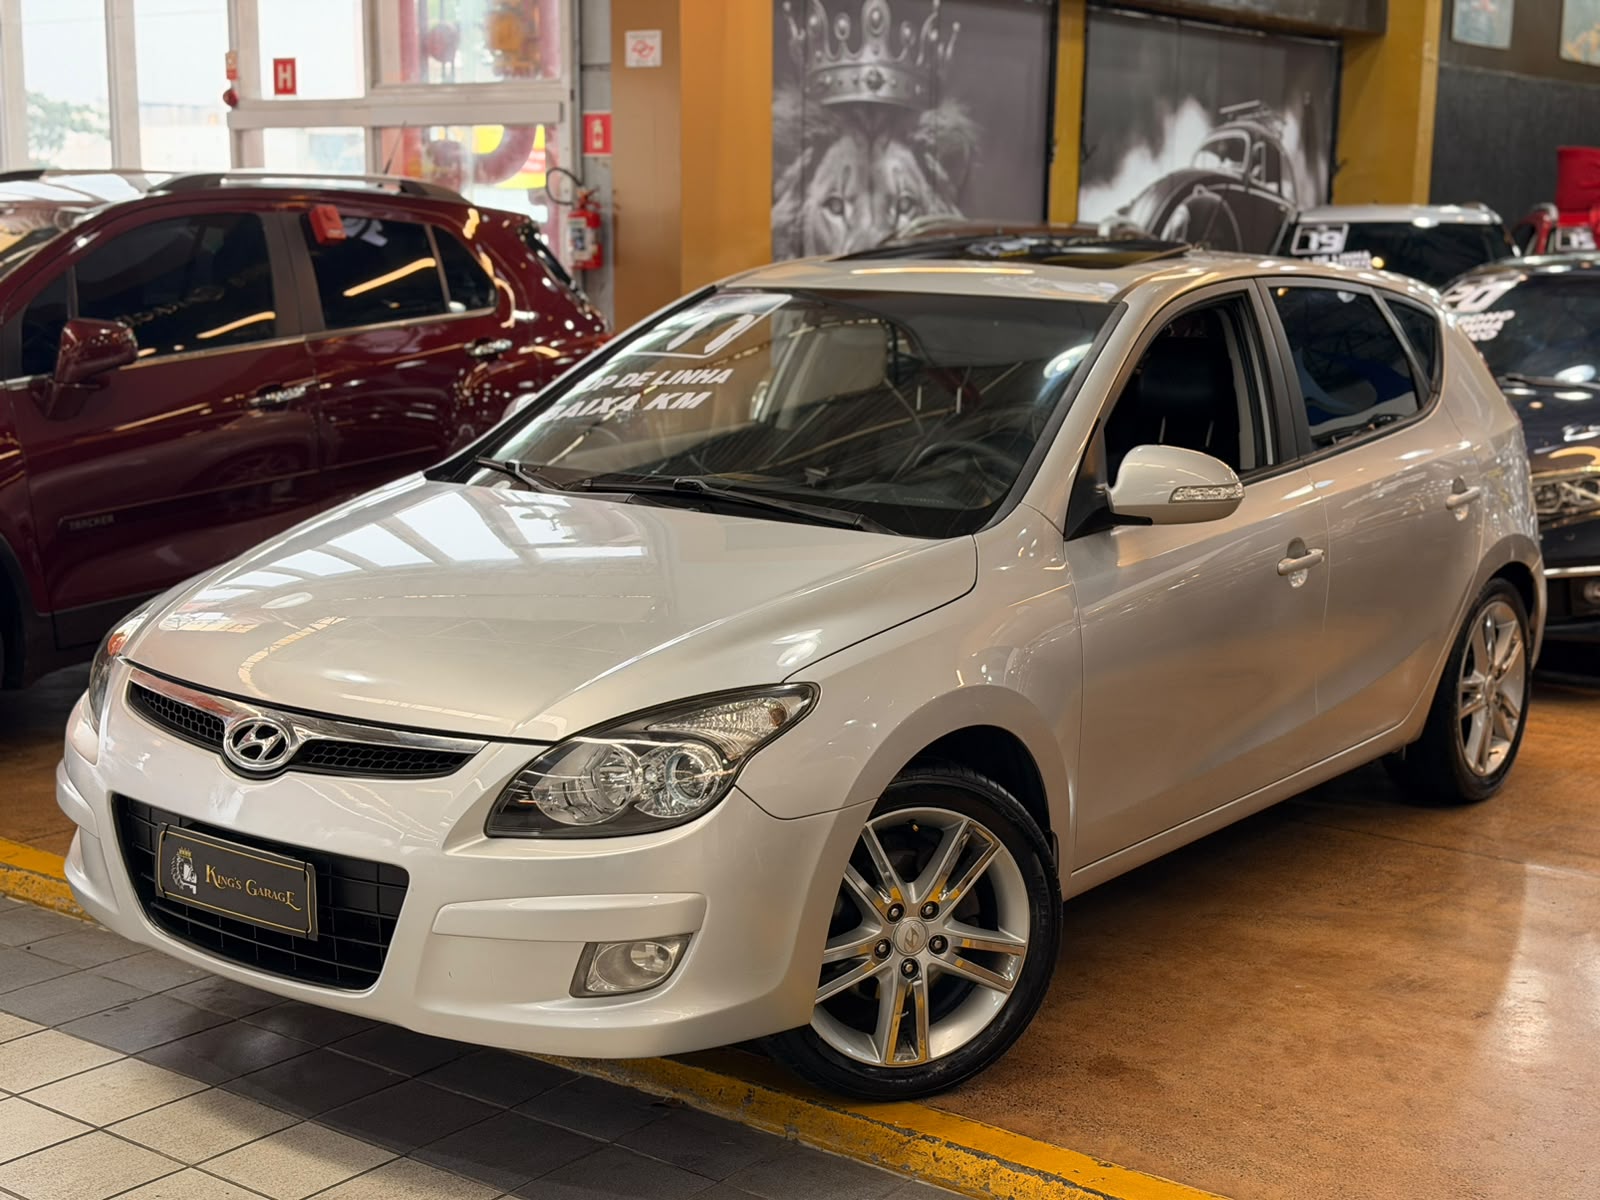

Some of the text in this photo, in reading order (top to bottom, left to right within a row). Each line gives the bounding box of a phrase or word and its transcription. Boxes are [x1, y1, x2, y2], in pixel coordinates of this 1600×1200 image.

[277, 62, 293, 90] H
[1304, 230, 1341, 252] 19
[613, 371, 656, 389] DE
[655, 368, 734, 387] LINHA
[541, 391, 712, 421] BAIXA KM
